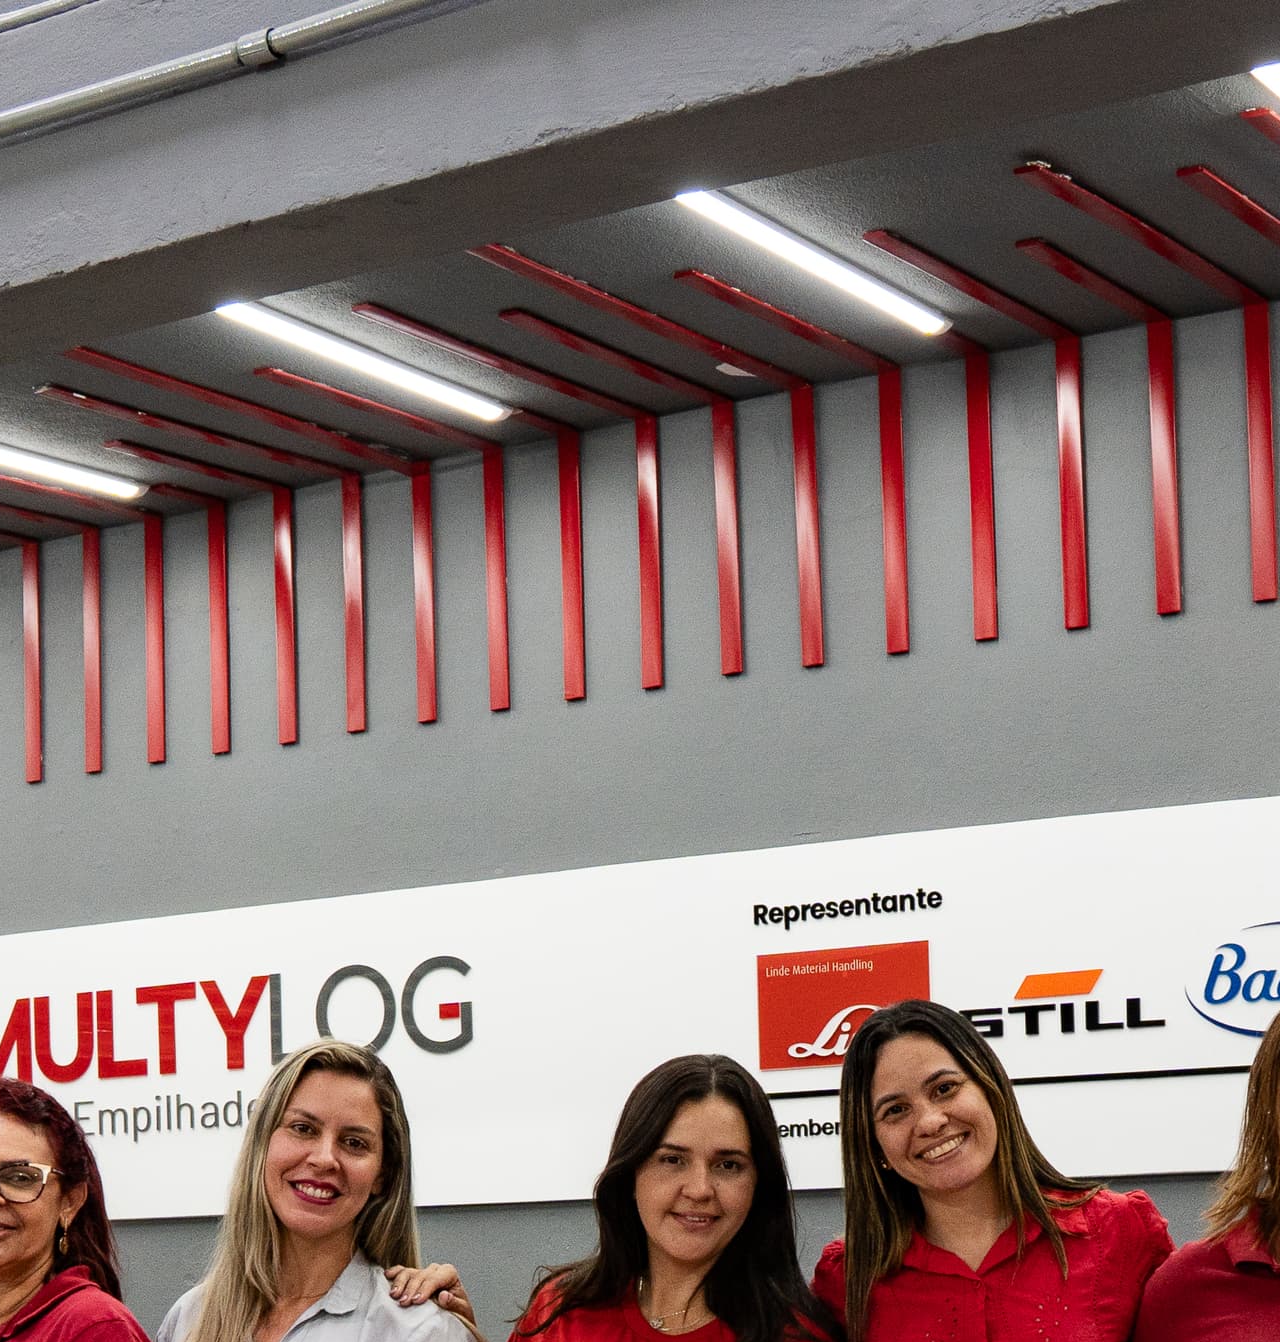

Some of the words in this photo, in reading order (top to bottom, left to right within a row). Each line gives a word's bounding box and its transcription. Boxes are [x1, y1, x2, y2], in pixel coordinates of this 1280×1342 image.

[753, 888, 943, 930] Representante
[765, 965, 790, 978] Linde
[792, 962, 830, 976] Material
[832, 959, 874, 972] Handling
[959, 997, 1166, 1037] STILL
[778, 1118, 841, 1138] ember
